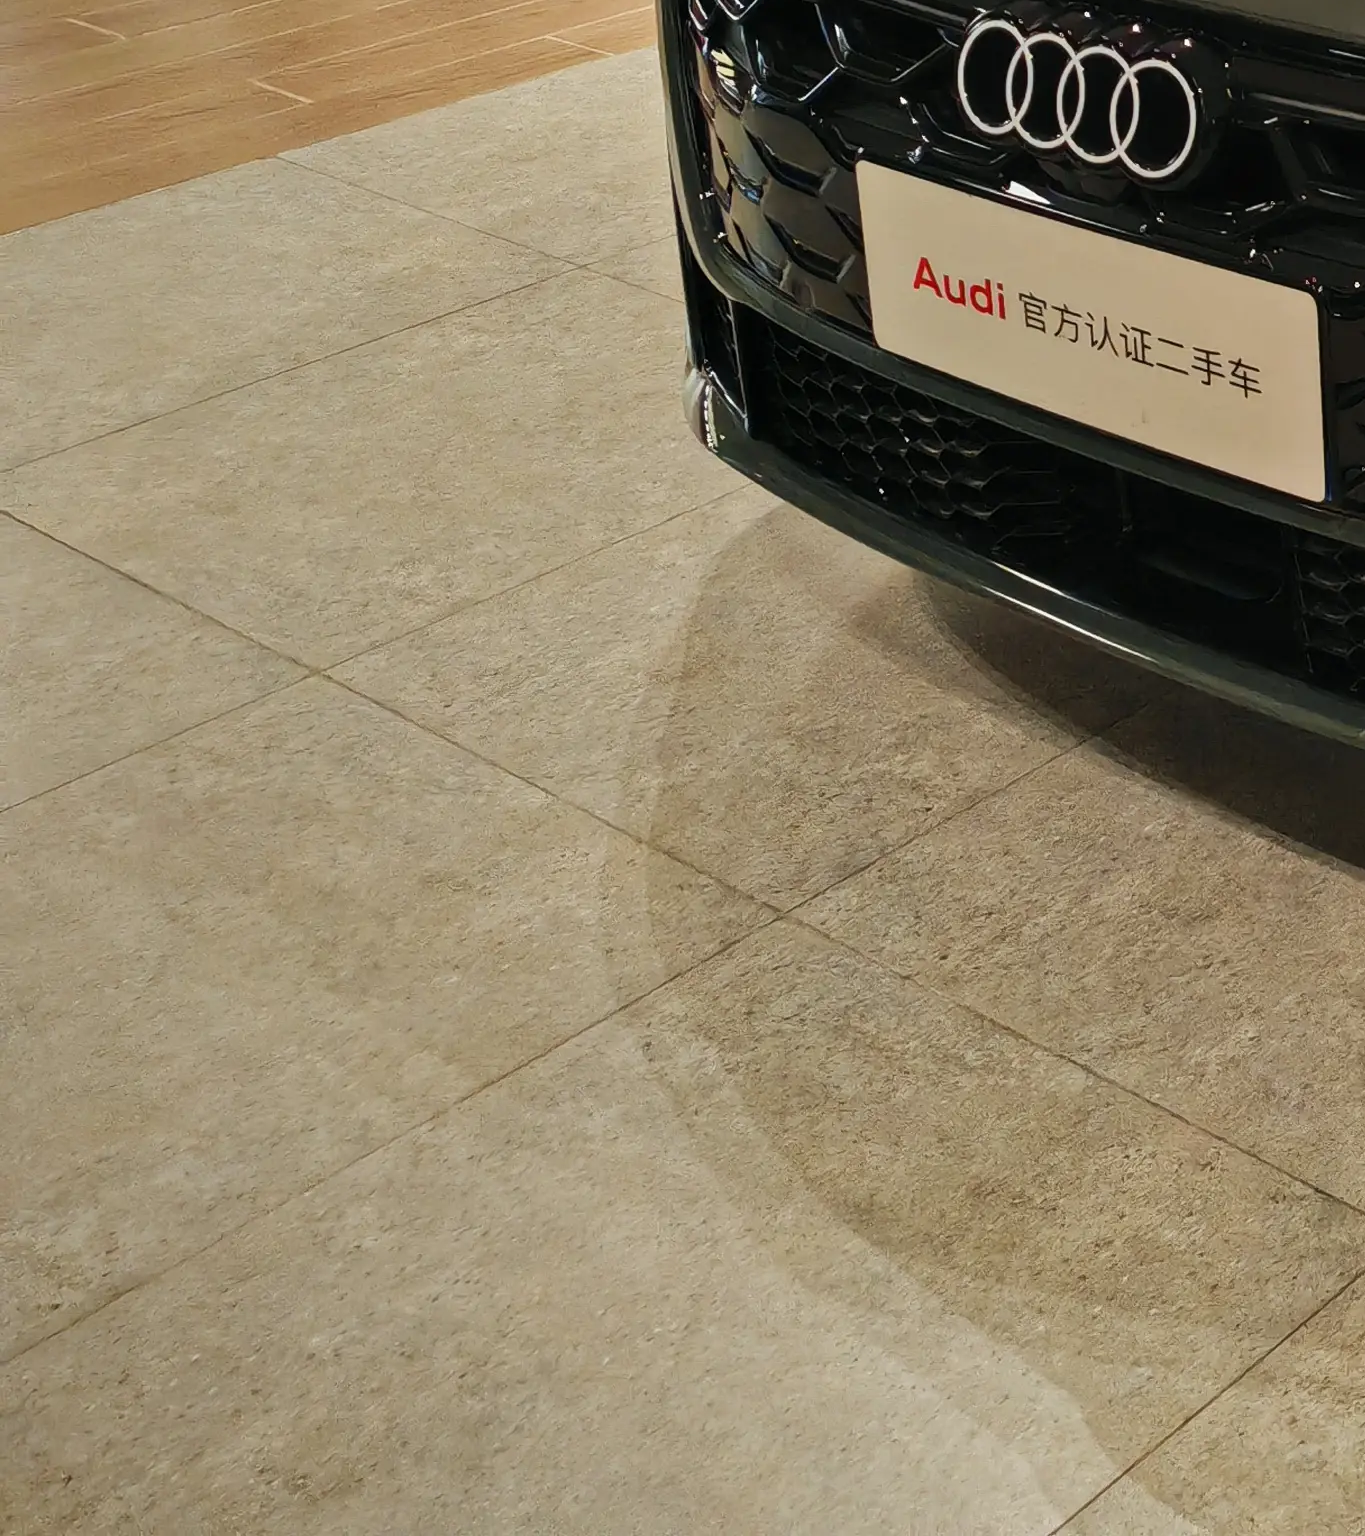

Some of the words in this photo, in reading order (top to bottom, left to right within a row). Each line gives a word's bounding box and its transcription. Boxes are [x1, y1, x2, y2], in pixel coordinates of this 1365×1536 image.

[913, 257, 1006, 319] Audi
[1019, 292, 1262, 398] 官方认证二手车
